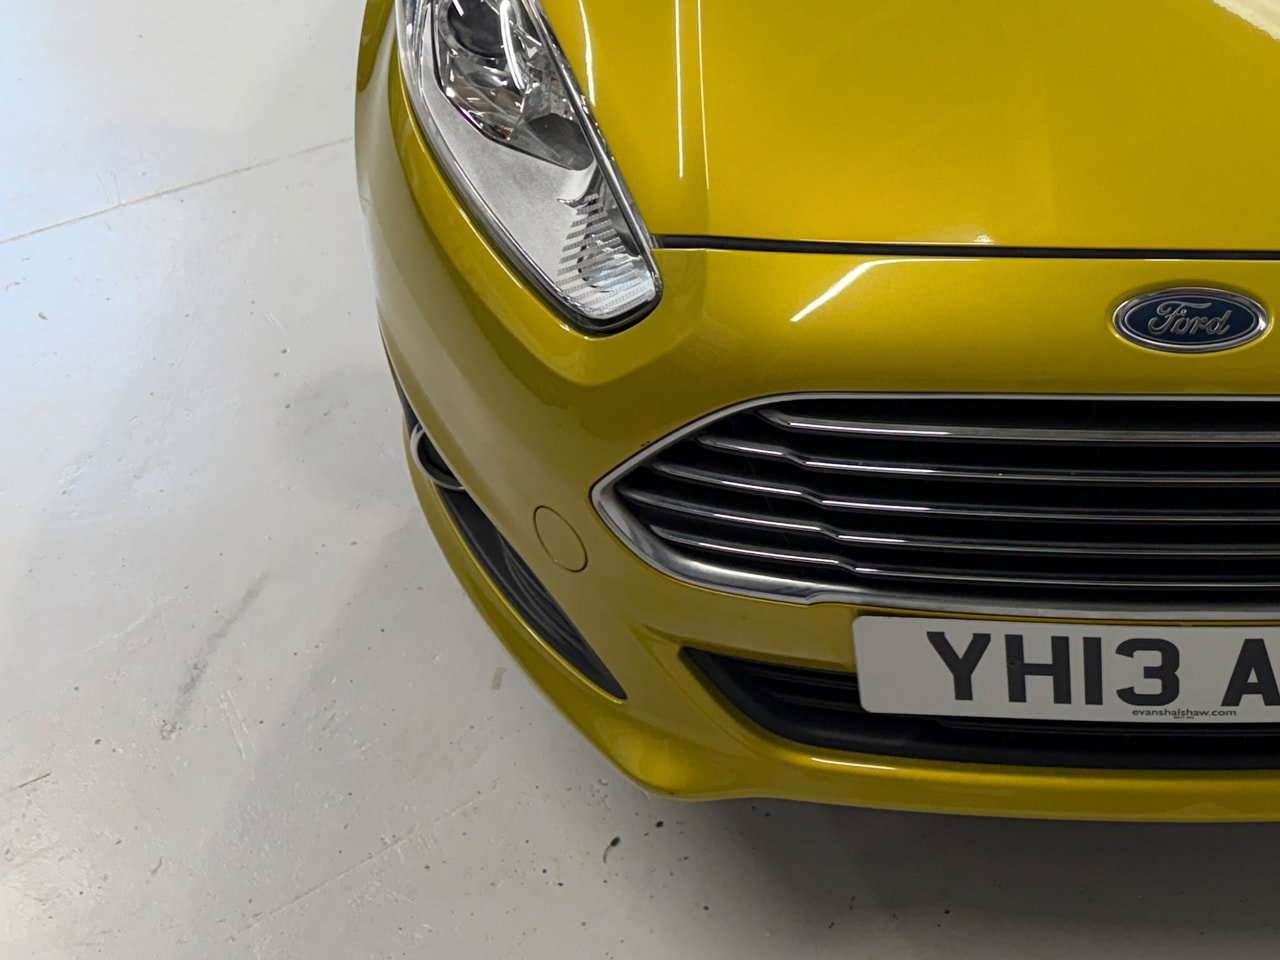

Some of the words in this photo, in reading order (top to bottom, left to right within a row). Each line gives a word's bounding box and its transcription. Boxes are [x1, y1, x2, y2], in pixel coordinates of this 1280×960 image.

[1148, 300, 1232, 335] Ford
[926, 631, 1181, 707] YH13
[1131, 707, 1237, 717] evanshalshaw.com
